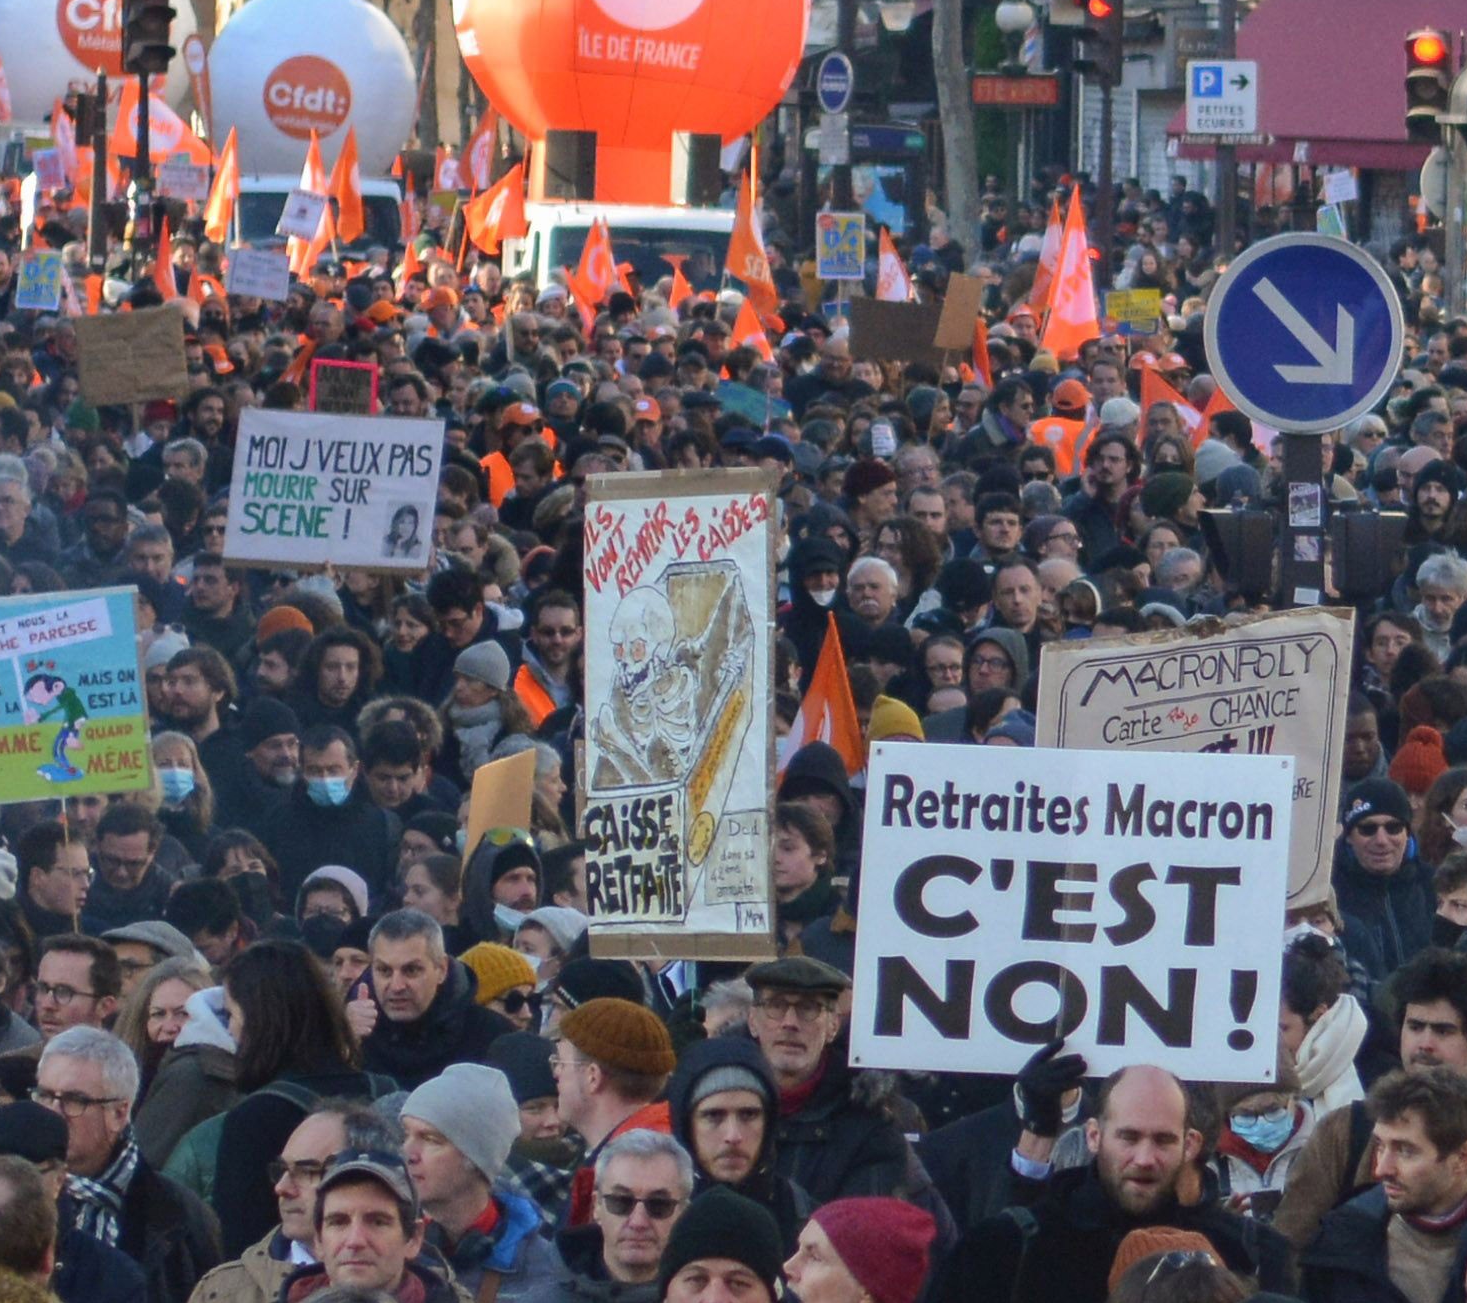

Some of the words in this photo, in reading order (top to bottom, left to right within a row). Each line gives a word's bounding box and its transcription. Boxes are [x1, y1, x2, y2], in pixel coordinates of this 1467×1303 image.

[578, 26, 604, 58] ÎLE
[607, 35, 631, 62] DE
[634, 38, 702, 70] FRANCE
[269, 82, 346, 113] Cfdt:
[1220, 133, 1264, 145] ANTOINE
[247, 435, 288, 469] MOI
[387, 444, 433, 477] PAS
[242, 472, 319, 501] MOURIR
[328, 477, 372, 505] SUR
[240, 502, 333, 539] SCENE
[342, 507, 353, 540] !
[670, 506, 700, 560] LES
[18, 615, 46, 630] NOUS
[56, 610, 69, 622] LA
[28, 619, 98, 643] PARESSE
[78, 670, 114, 688] MAIS
[117, 669, 137, 682] ON
[5, 701, 21, 713] LA
[87, 693, 116, 710] EST
[1102, 708, 1164, 745] Carte
[1209, 686, 1301, 728] CHANCE
[85, 723, 134, 742] QUAND
[881, 773, 1090, 837] Retraites
[1104, 782, 1274, 841] Macron
[893, 853, 1242, 947] C'EST
[873, 955, 1198, 1049] NON
[1226, 968, 1259, 1052] !
